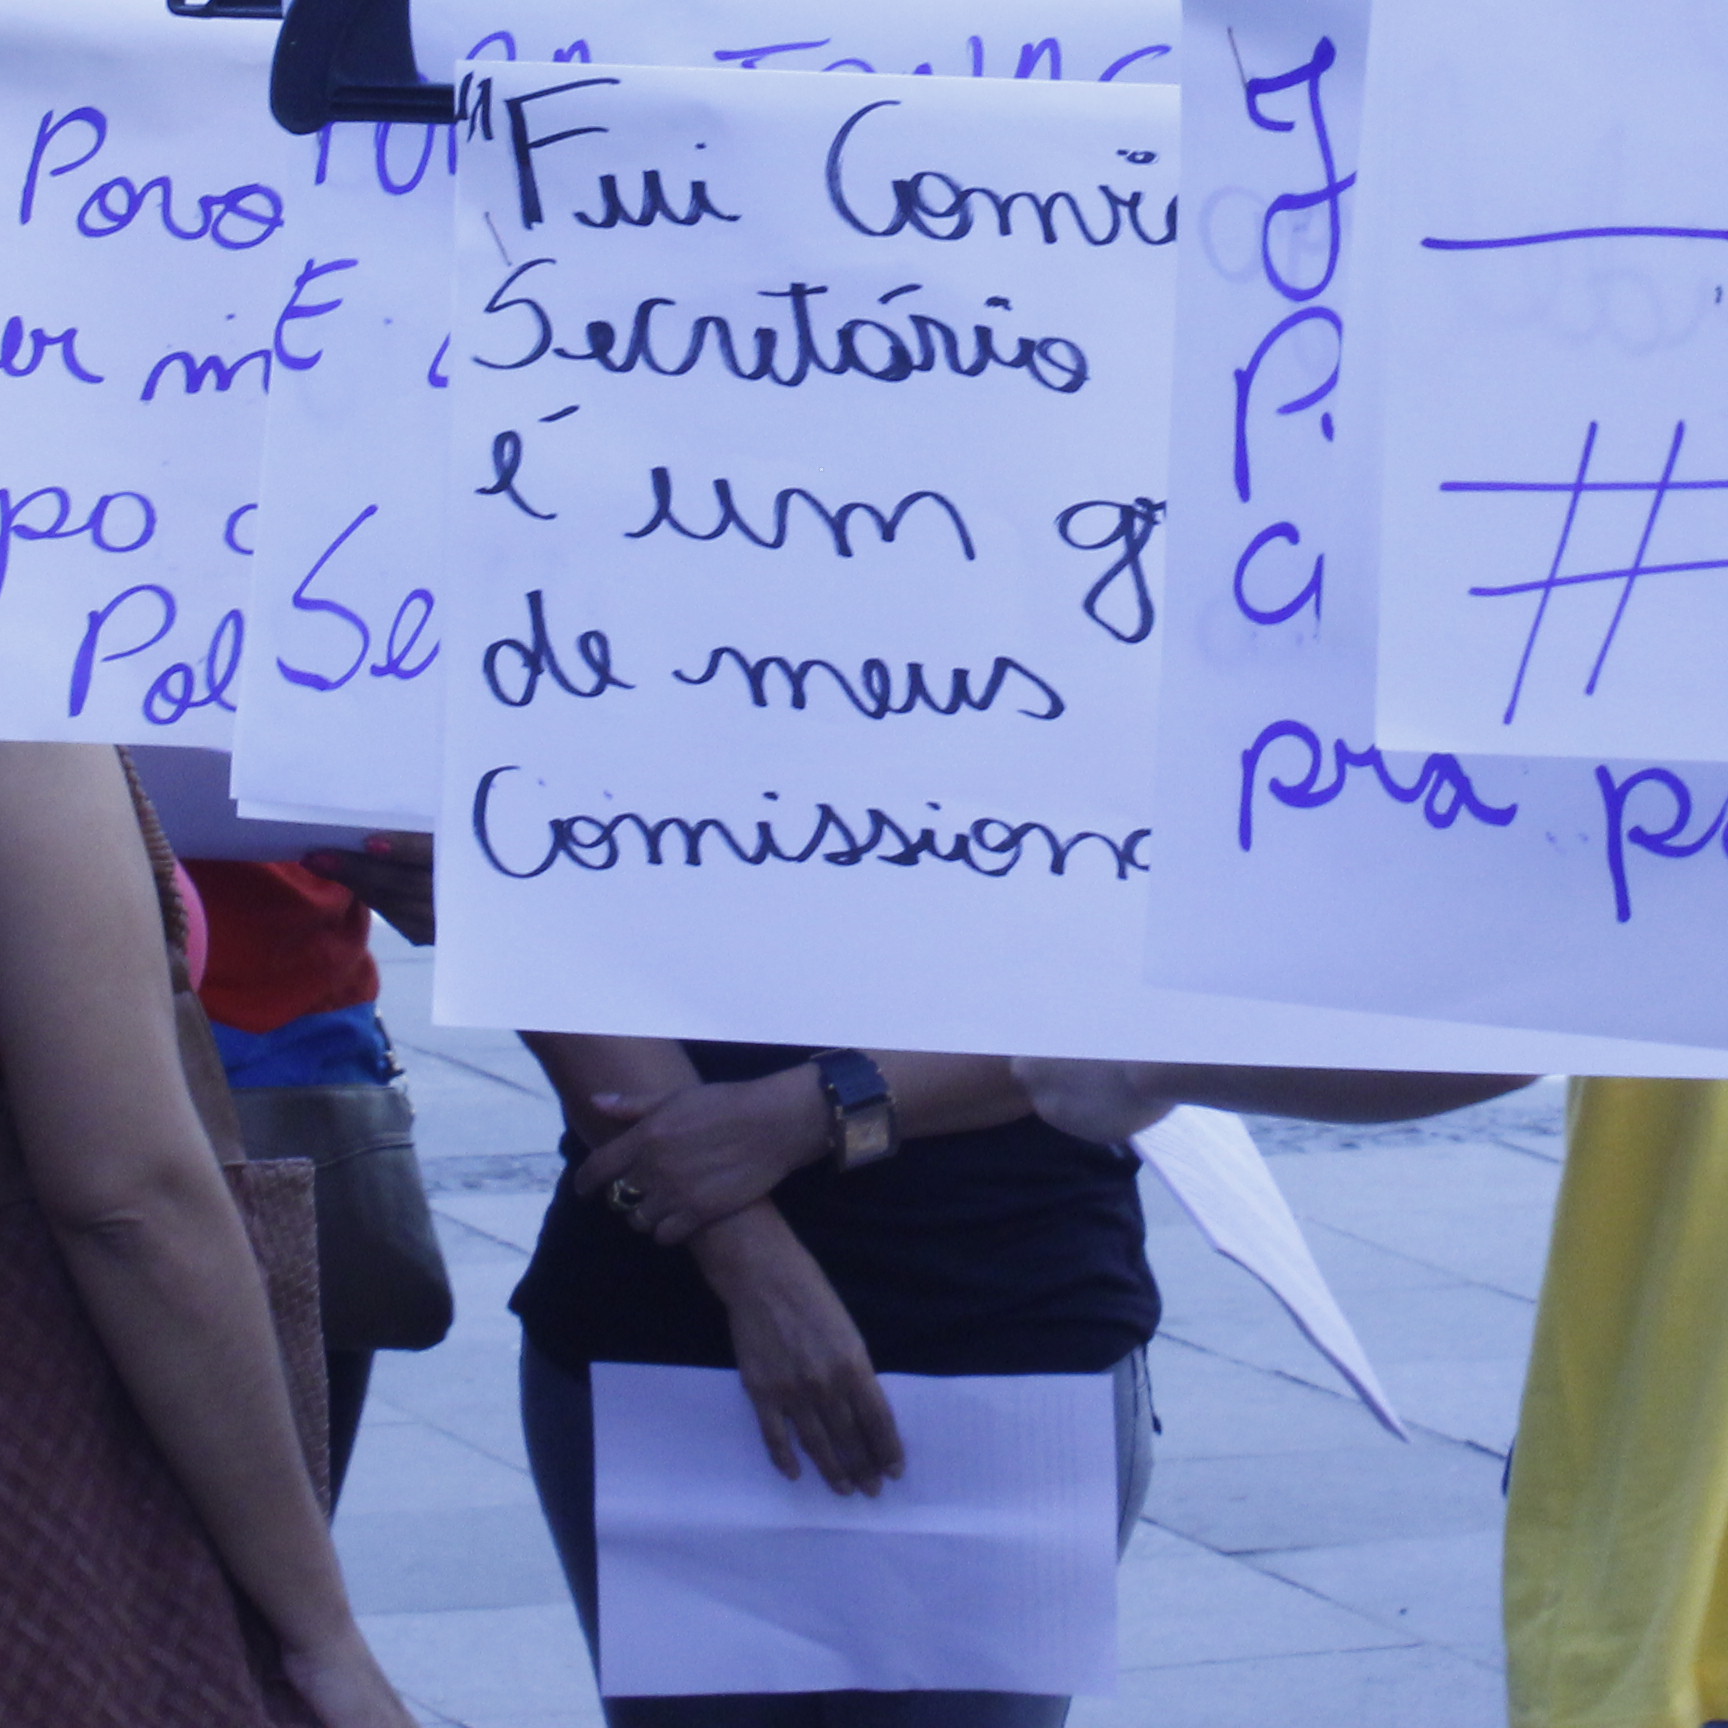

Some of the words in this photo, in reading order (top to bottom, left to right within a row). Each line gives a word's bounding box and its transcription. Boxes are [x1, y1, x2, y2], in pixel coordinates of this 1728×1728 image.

[20, 106, 285, 251] Povo
[472, 258, 1090, 394] Secretário
[622, 466, 977, 561] um
[481, 588, 637, 708] de
